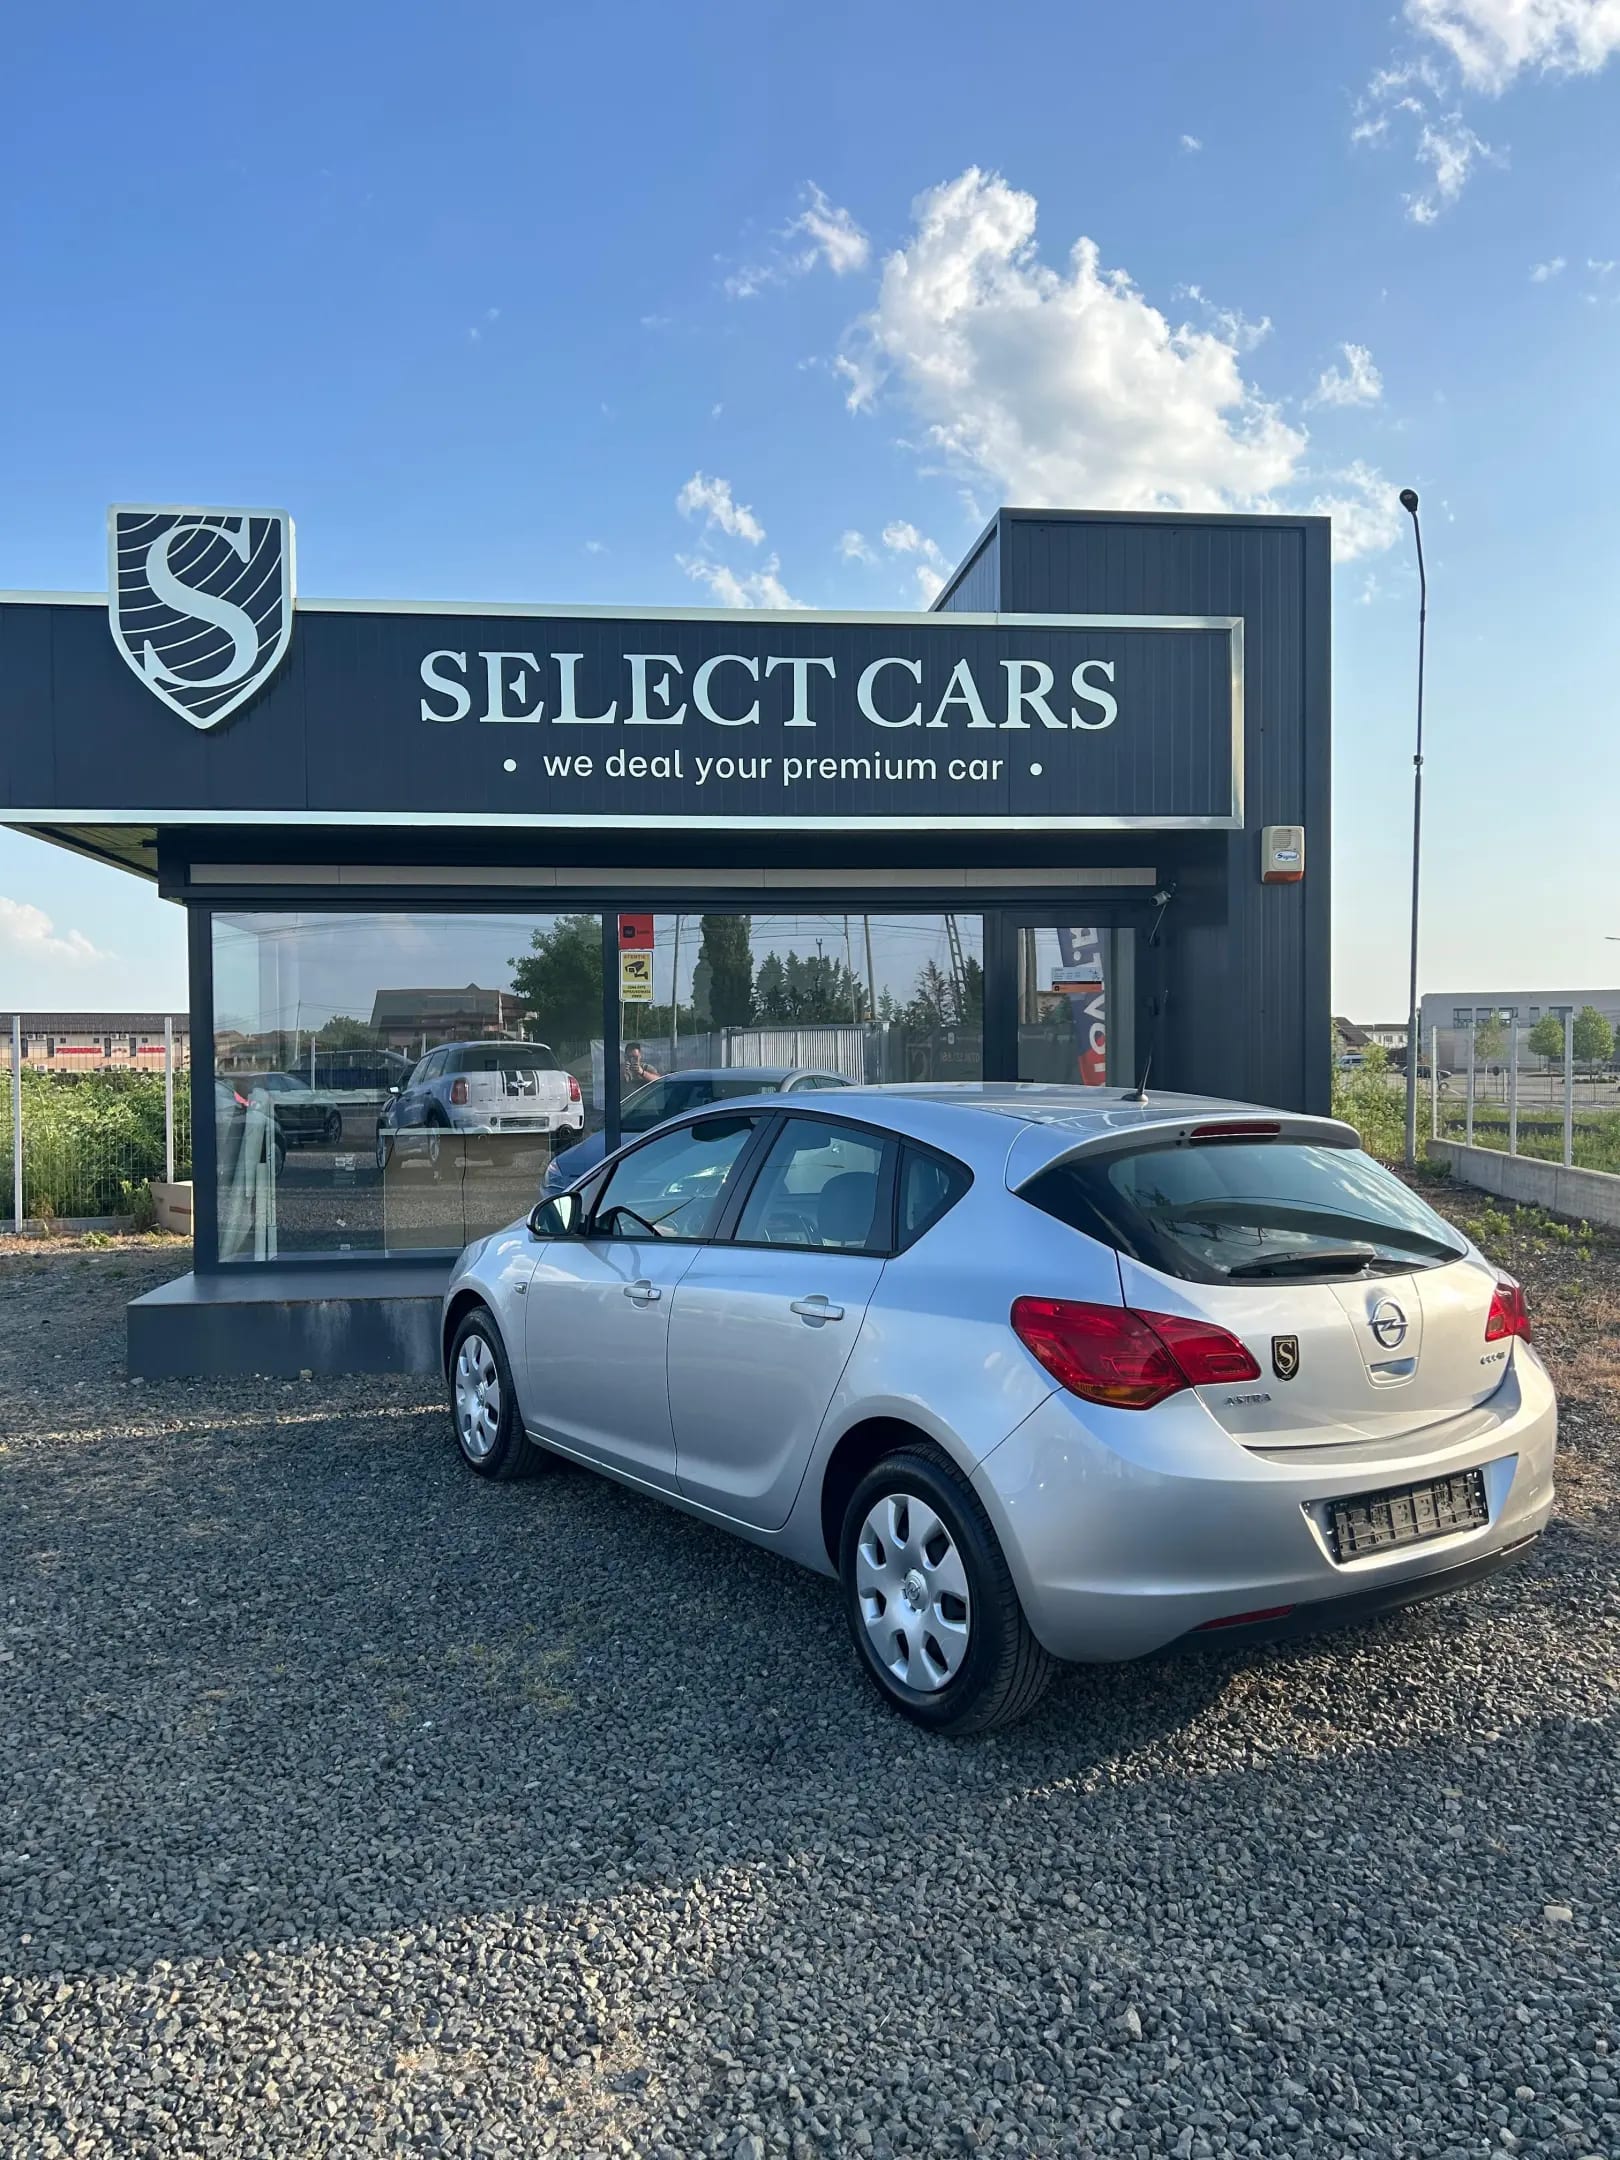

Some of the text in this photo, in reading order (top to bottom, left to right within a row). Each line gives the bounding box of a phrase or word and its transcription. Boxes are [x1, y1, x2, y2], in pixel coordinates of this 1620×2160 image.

[420, 650, 1118, 730] SELECT CARS
[543, 748, 1005, 787] we deal your premium car
[1223, 1392, 1272, 1406] ASTRA
